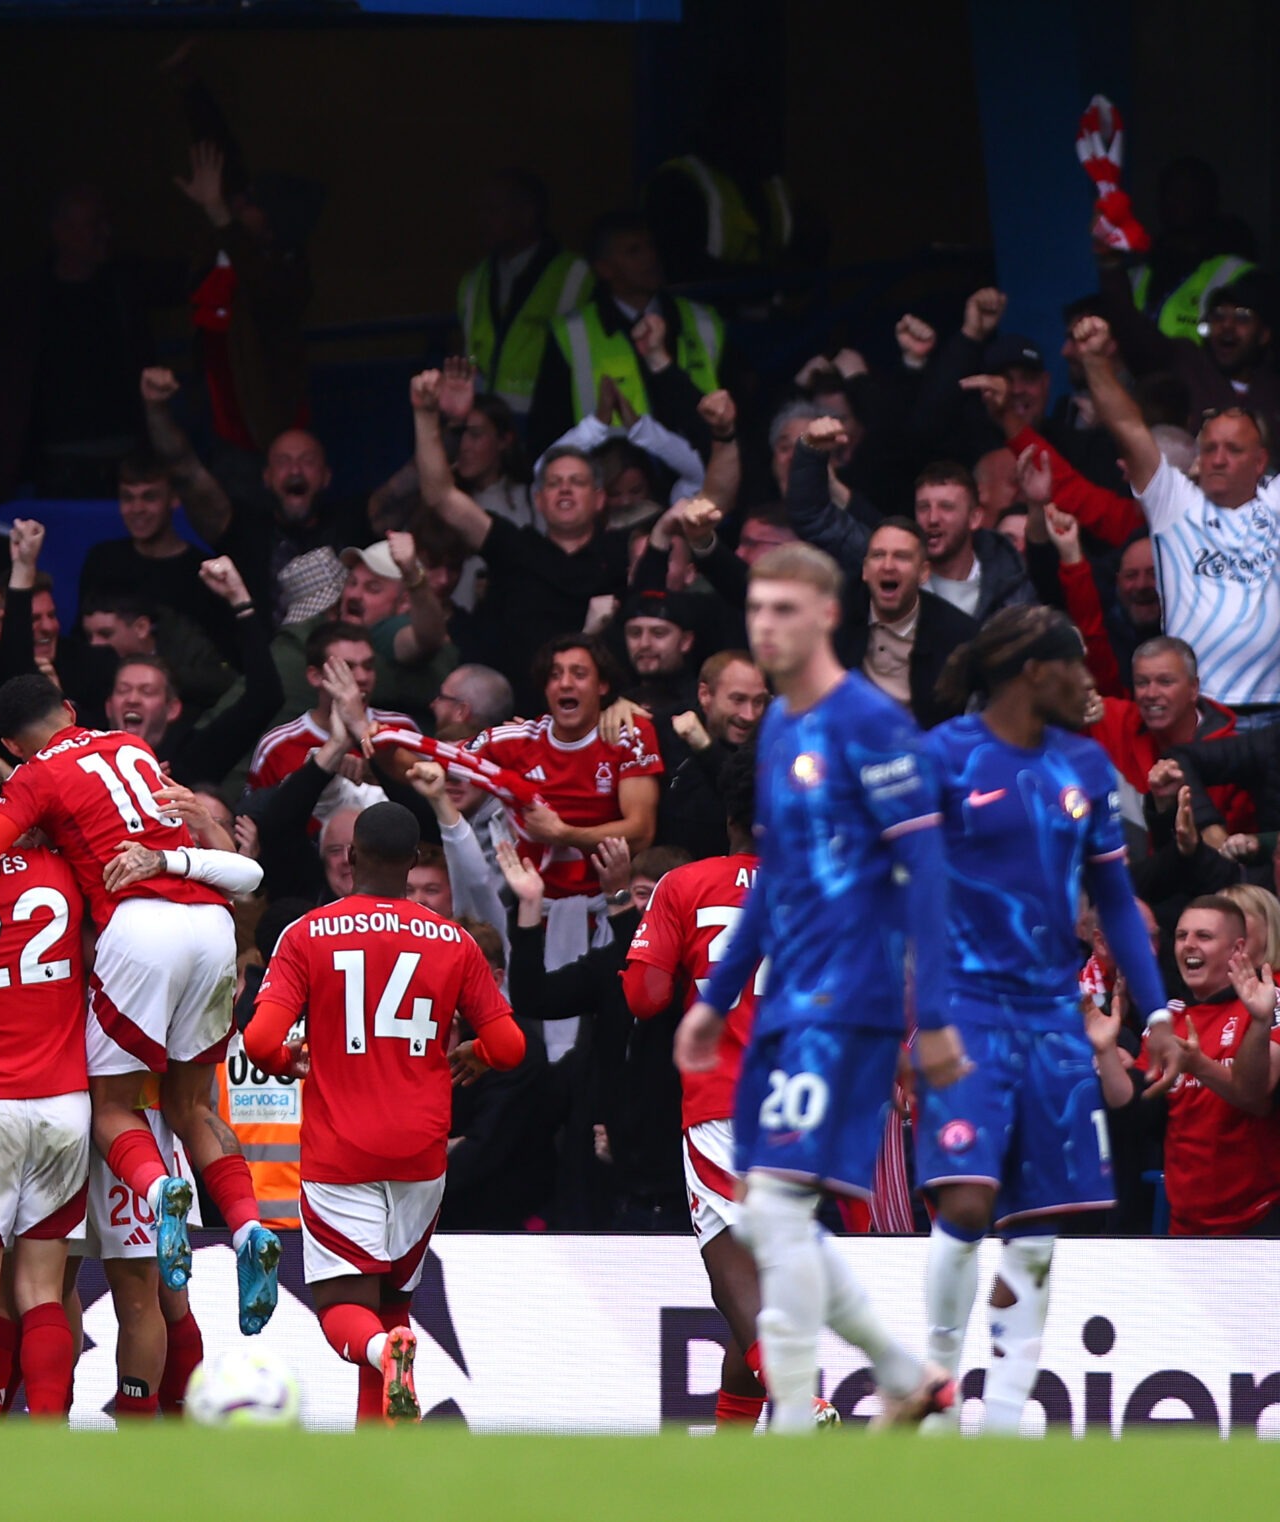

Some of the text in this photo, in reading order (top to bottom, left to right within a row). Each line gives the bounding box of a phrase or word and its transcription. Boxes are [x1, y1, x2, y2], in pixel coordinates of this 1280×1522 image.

[76, 745, 183, 834] 10
[309, 913, 462, 943] HUDSON-ODOI
[333, 950, 438, 1056] 14
[234, 1094, 289, 1106] servoca
[758, 1068, 830, 1132] 20
[109, 1185, 155, 1226] 20
[660, 1306, 1280, 1431] Pemier
